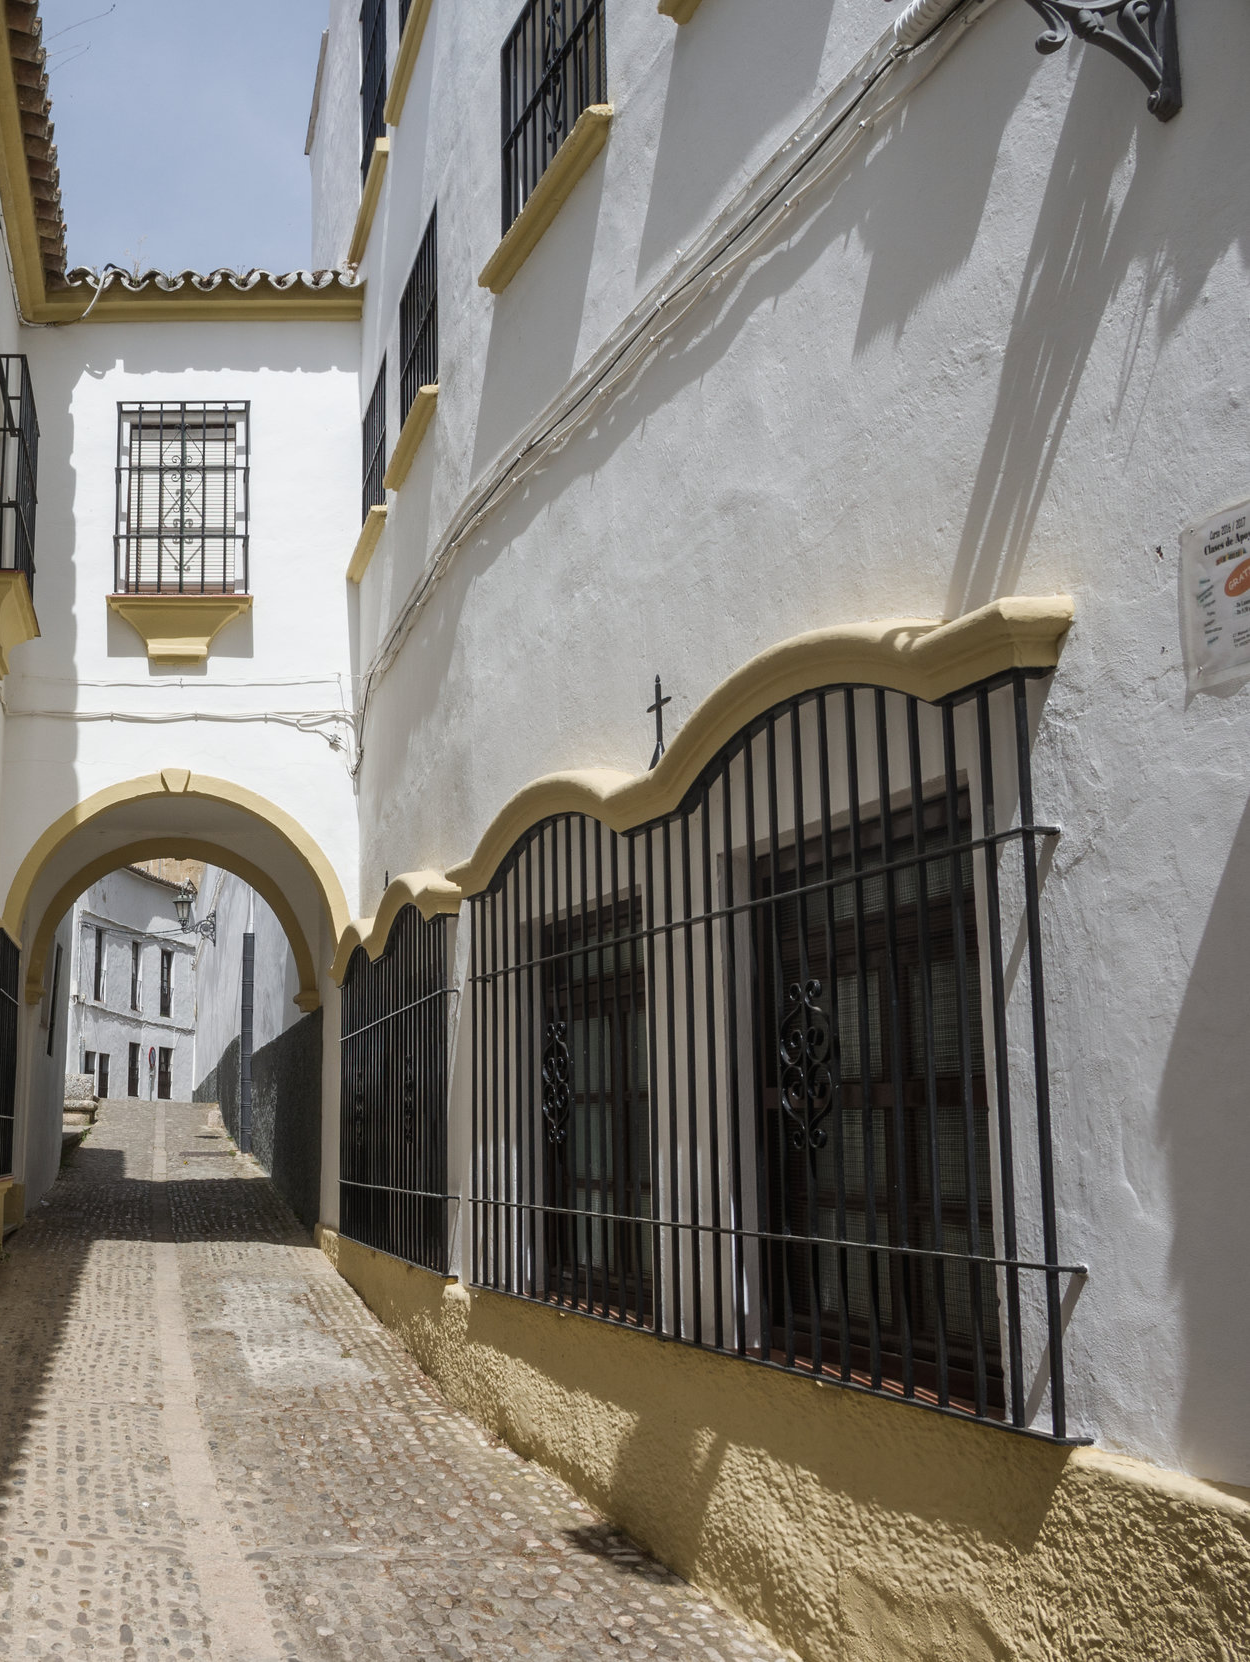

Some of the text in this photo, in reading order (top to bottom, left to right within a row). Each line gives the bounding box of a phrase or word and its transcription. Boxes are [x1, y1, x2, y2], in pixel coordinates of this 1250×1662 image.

[1221, 523, 1231, 535] 2016
[1236, 516, 1246, 529] 2017
[1204, 543, 1224, 555] Clases
[1225, 536, 1234, 547] de
